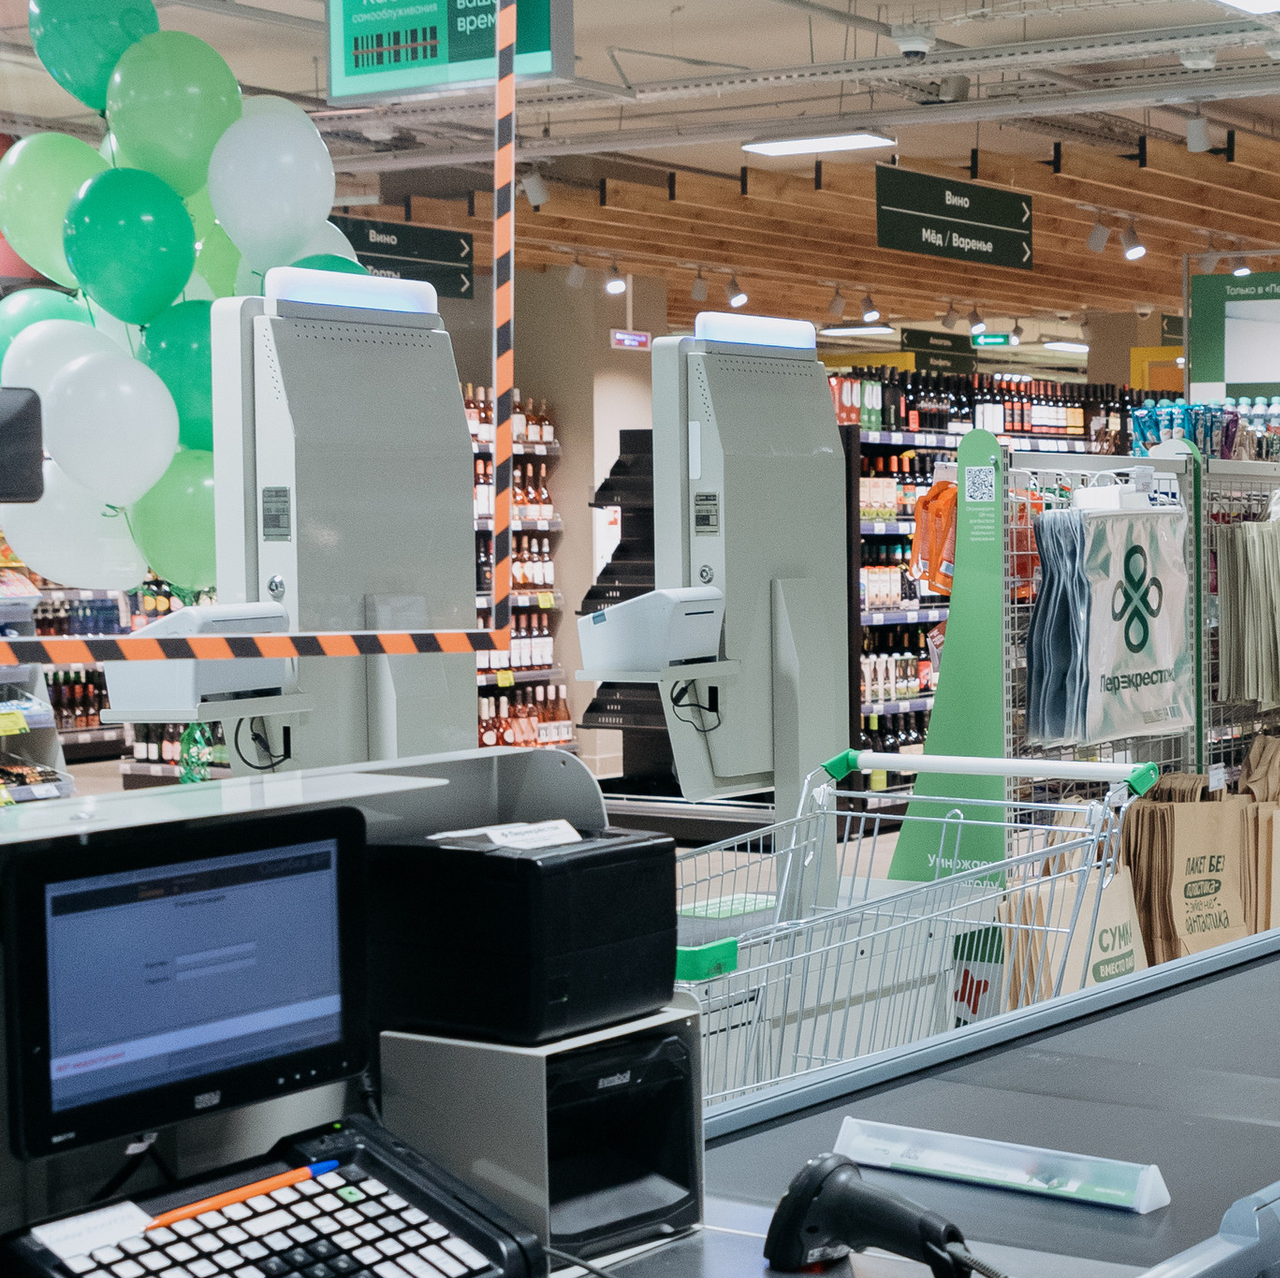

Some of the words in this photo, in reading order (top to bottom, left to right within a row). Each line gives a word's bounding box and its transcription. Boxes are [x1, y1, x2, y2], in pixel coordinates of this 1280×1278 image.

[945, 191, 970, 208] Вино
[368, 229, 397, 245] Вино
[921, 228, 943, 247] Мёд
[952, 233, 993, 252] Варенье
[1225, 285, 1256, 295] Только
[1257, 286, 1264, 294] в
